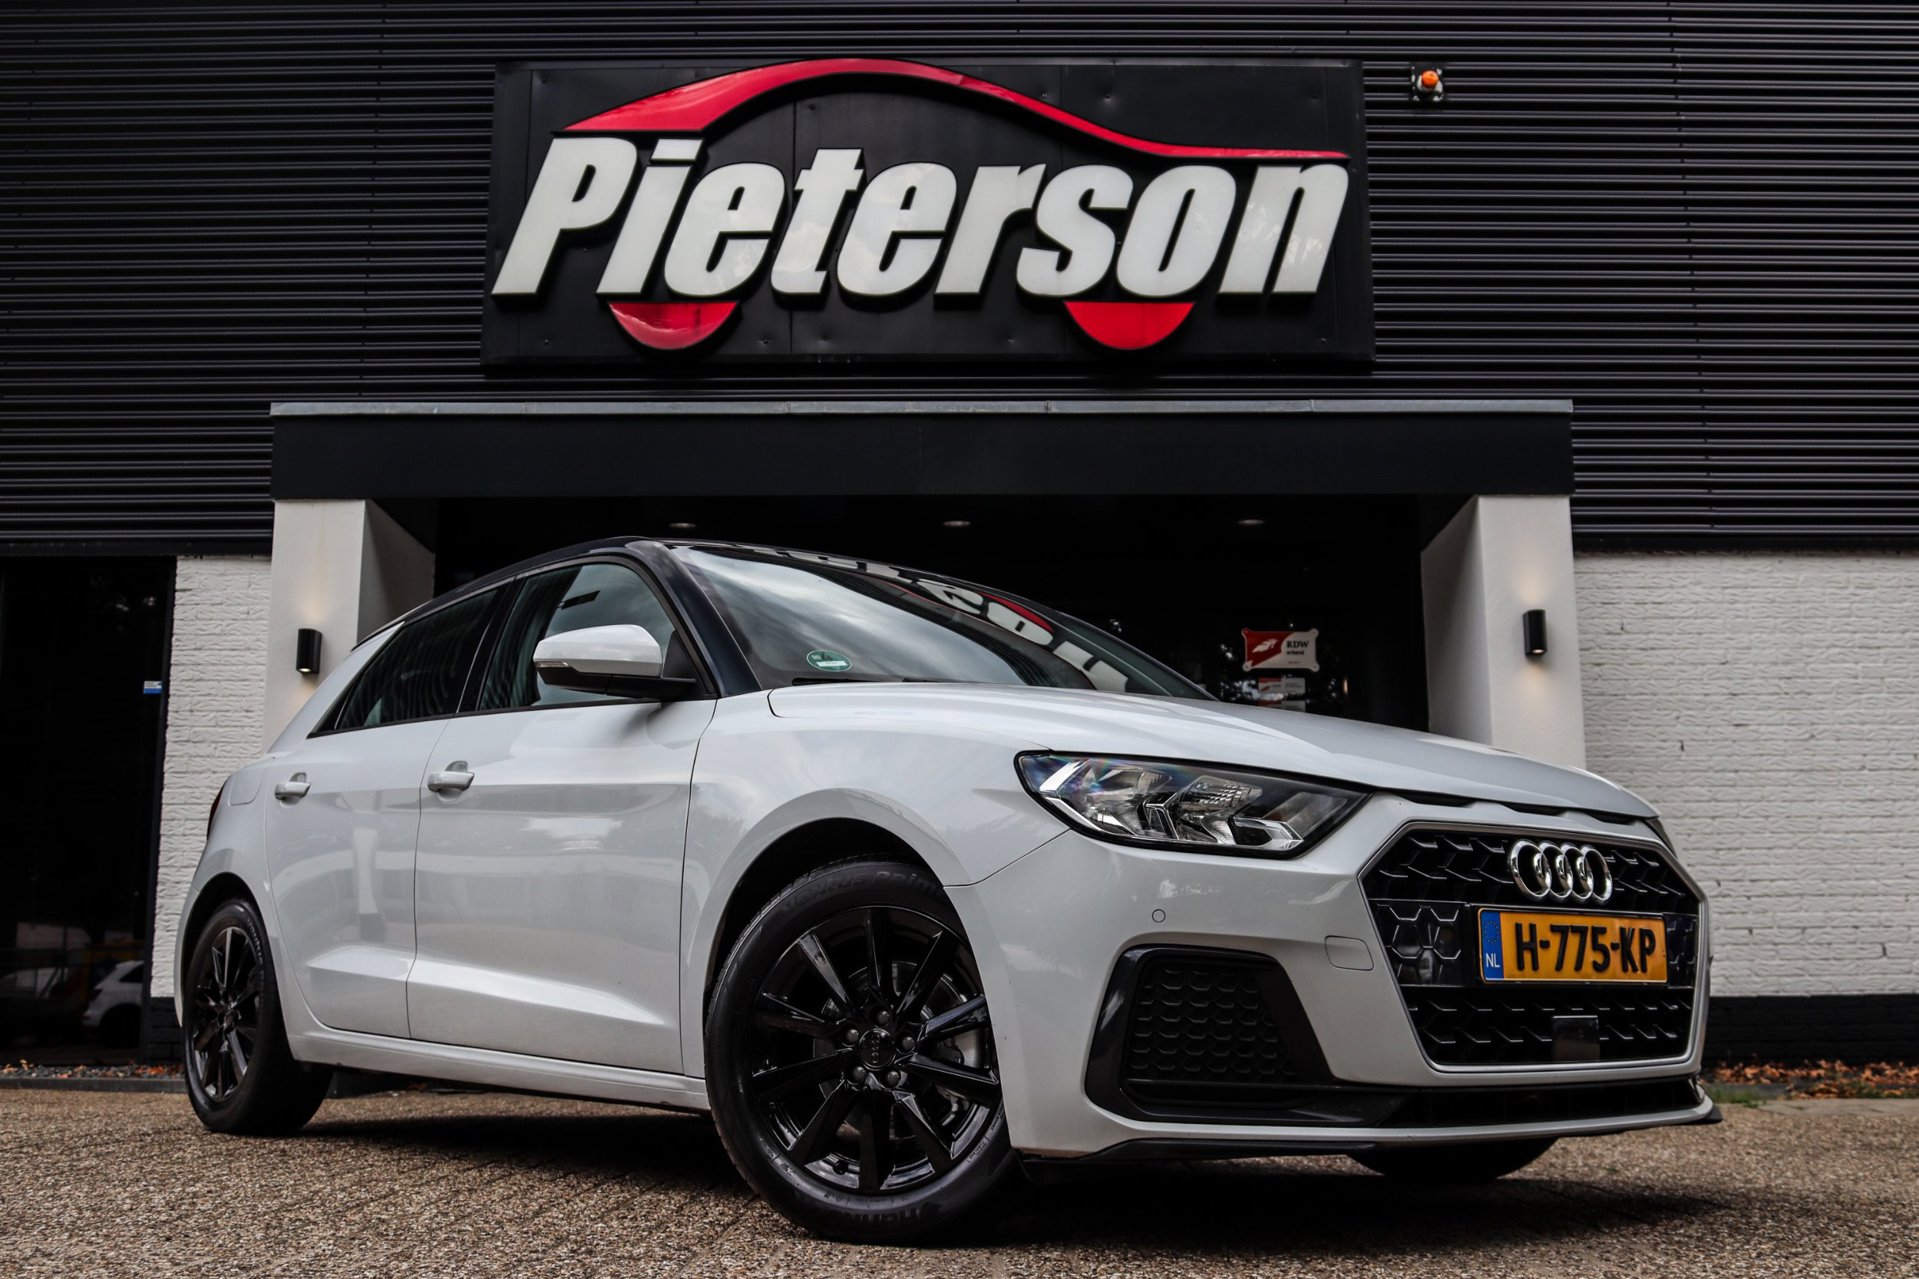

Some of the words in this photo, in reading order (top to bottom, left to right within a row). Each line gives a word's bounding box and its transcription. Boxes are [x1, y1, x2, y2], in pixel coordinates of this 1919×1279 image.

[491, 136, 1350, 299] Pieterson
[1286, 640, 1309, 648] RDW
[1485, 953, 1501, 969] NL
[1514, 922, 1657, 974] H-775-KP
